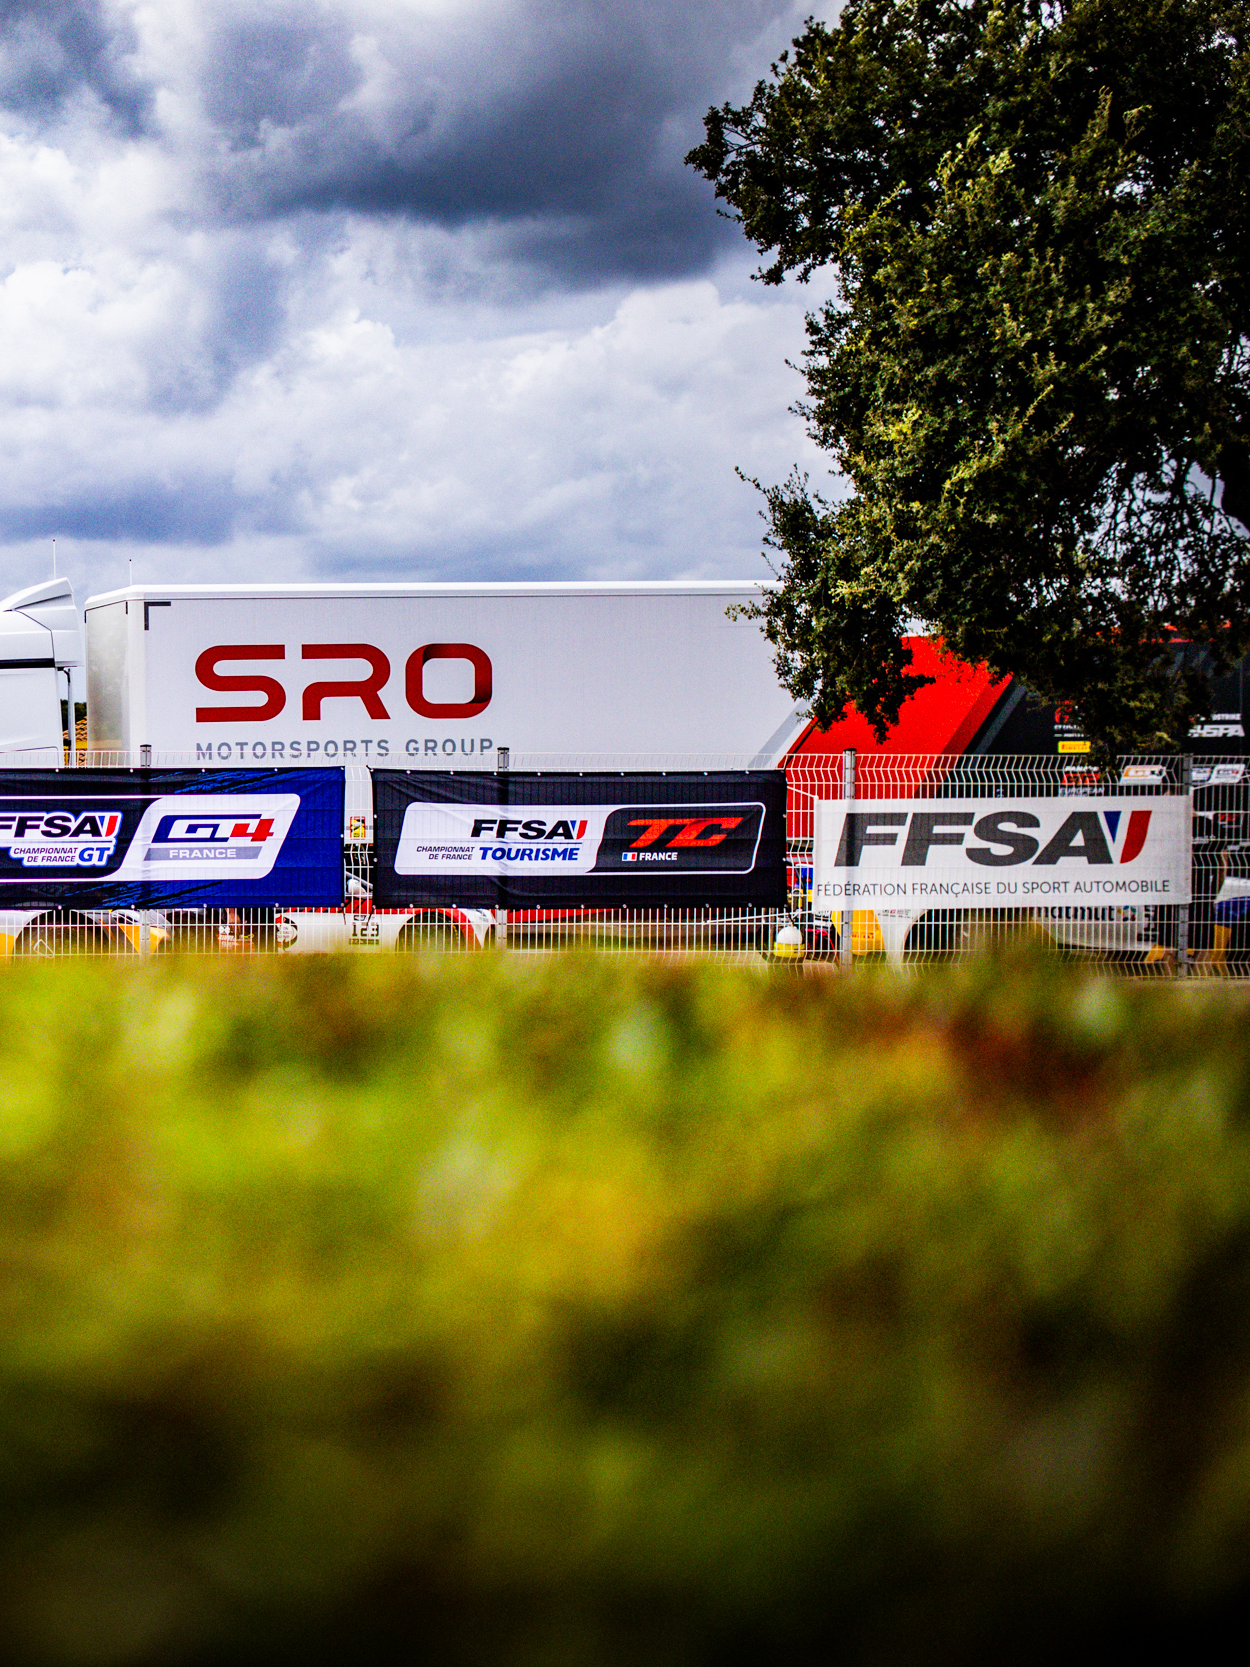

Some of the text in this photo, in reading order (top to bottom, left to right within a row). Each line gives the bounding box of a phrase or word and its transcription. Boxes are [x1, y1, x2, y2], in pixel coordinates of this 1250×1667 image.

[195, 643, 493, 723] SRO
[195, 737, 494, 762] MOTORSPORTS GROUP
[152, 814, 274, 843] GT4
[470, 819, 577, 840] FFSA
[627, 817, 744, 848] TC
[834, 811, 1114, 867] FFSA
[13, 847, 79, 855] CHAMPIONNAT
[41, 855, 76, 863] FRANCE
[79, 847, 109, 863] GT
[169, 848, 237, 858] FRANCE
[479, 847, 579, 861] TOURISME
[639, 852, 678, 861] FRANCE
[817, 880, 1171, 898] FÉDÉRATION FRANÇAISE DU SPORT AUTOMOBILE
[351, 923, 379, 937] 123
